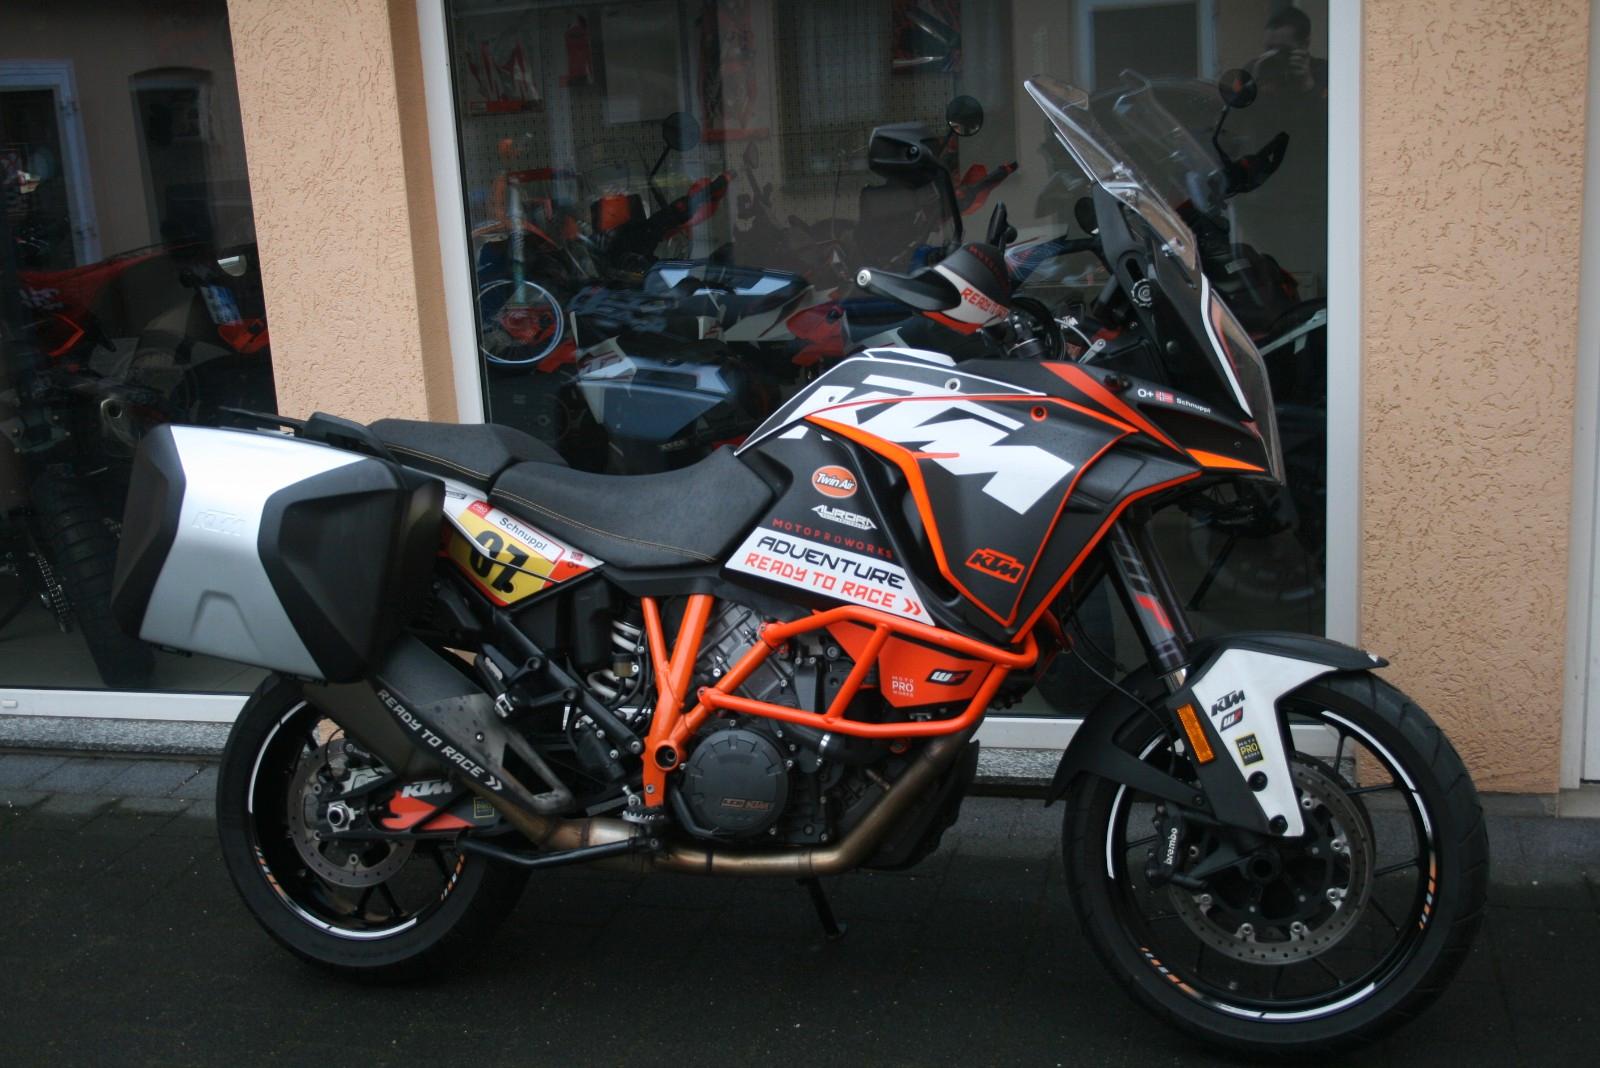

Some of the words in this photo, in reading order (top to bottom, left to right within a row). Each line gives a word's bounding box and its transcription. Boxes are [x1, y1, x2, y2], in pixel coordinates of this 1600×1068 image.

[815, 472, 837, 489] Twin
[836, 477, 856, 491] Air
[811, 504, 877, 530] AURORA
[772, 518, 894, 559] MOTOPROWORKS
[757, 536, 905, 590] ADVENTURE
[966, 549, 1025, 583] KTM
[744, 552, 807, 583] READY
[813, 571, 836, 591] TO
[840, 581, 896, 608] RACE
[891, 681, 914, 693] PRO
[1211, 690, 1246, 717] KTM
[377, 688, 423, 731] READY
[421, 729, 443, 748] TO
[441, 746, 485, 778] RACE
[1240, 743, 1258, 755] PRO
[401, 779, 453, 798] KTM
[1163, 828, 1178, 865] brembo
